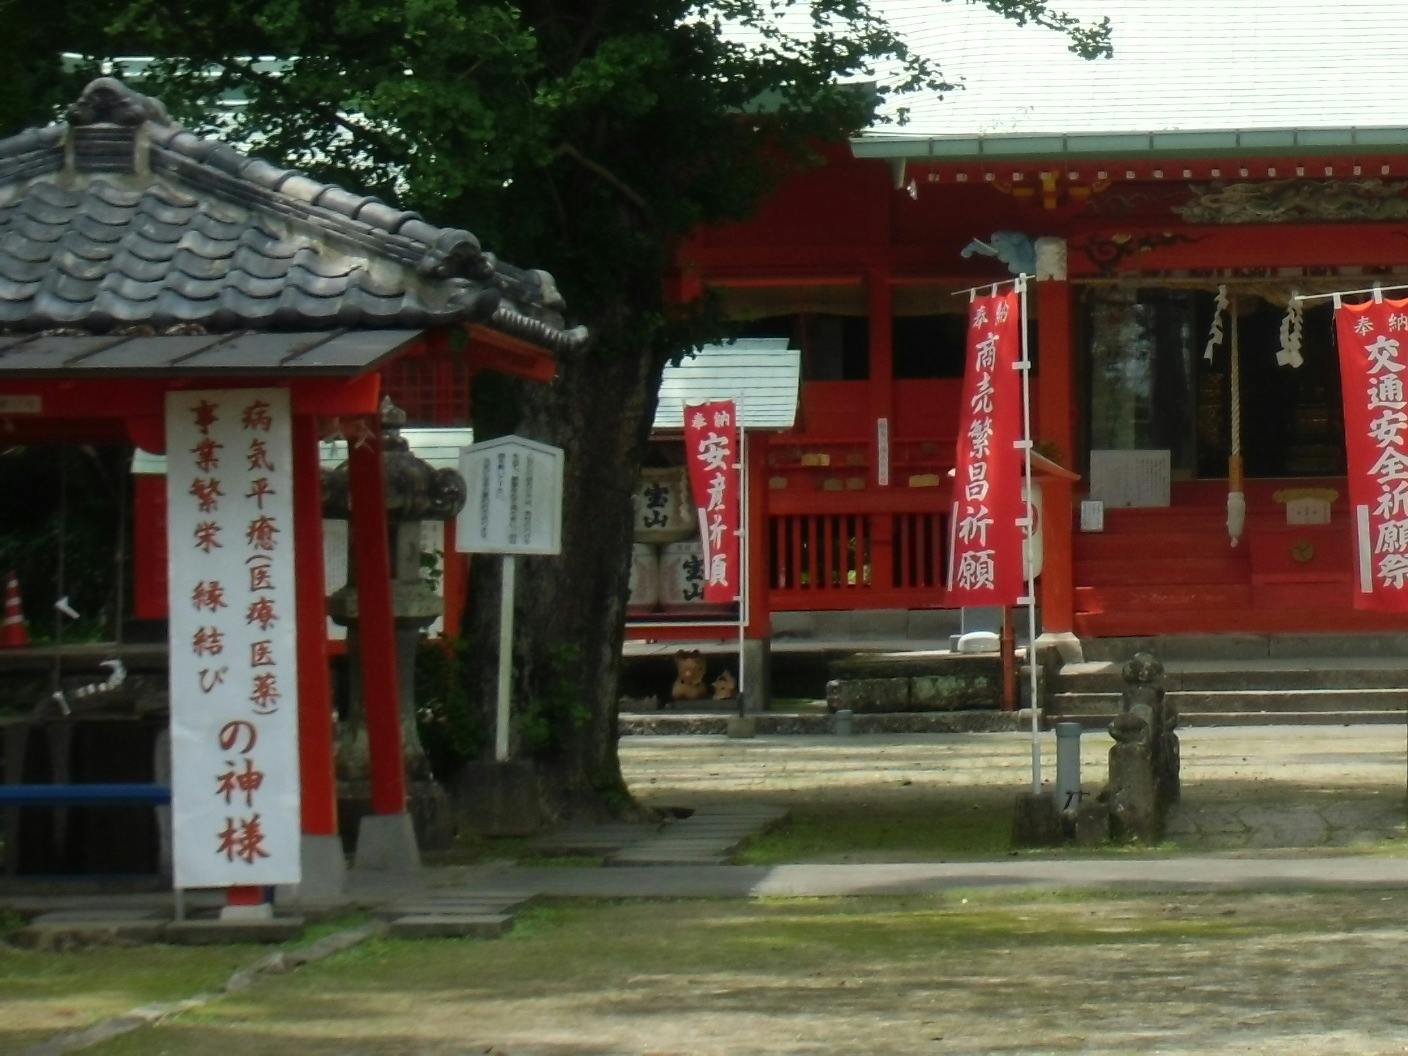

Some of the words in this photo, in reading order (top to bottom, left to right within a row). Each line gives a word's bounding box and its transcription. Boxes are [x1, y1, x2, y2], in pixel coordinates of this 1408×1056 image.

[973, 301, 1010, 330] 奉納
[1354, 313, 1408, 337] 奉納
[692, 410, 730, 430] 奉納
[957, 332, 999, 591] 商売繁昌祈願
[643, 483, 669, 529] 宝山
[191, 580, 228, 693] 縁結び
[216, 720, 270, 865] の神様
